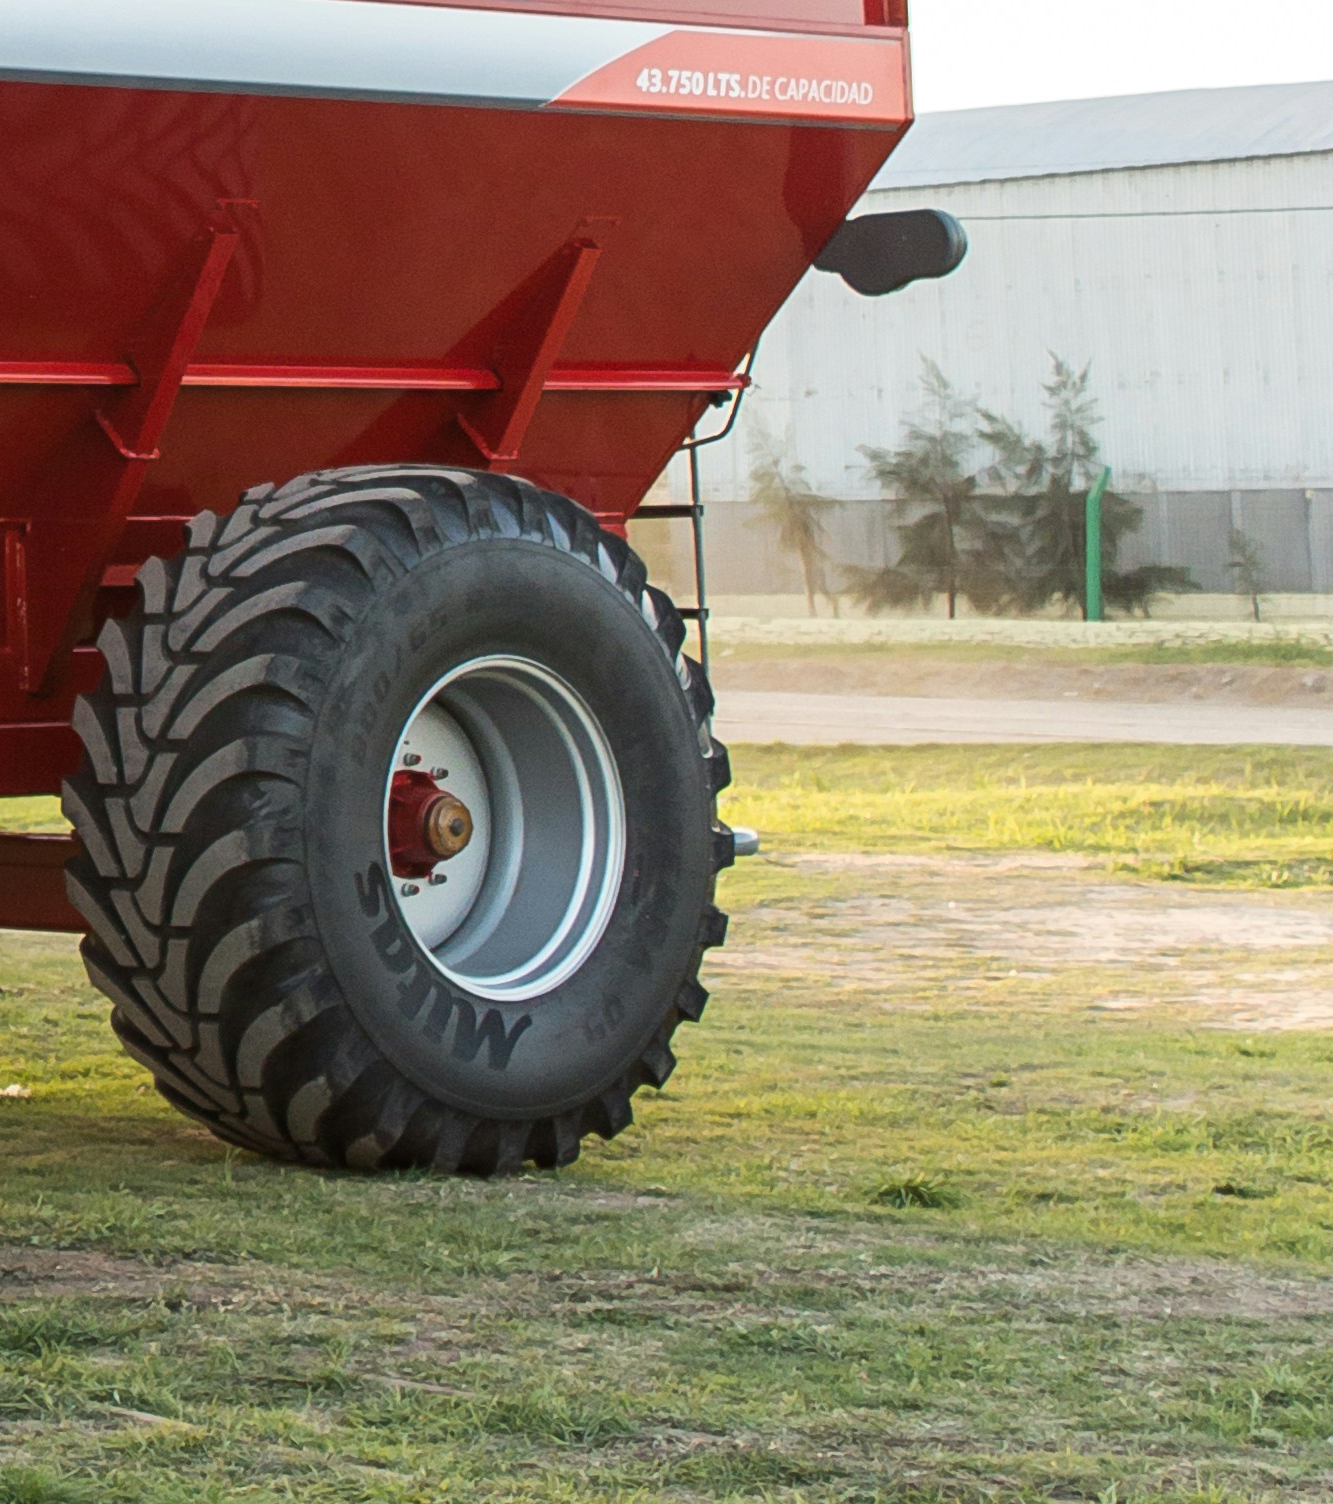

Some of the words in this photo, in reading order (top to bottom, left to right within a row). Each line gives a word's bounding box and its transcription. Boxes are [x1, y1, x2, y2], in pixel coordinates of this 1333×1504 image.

[636, 68, 704, 95] 43.750
[707, 72, 745, 98] LTS.
[748, 75, 770, 99] DE
[775, 77, 873, 105] CAPACIDAD
[354, 862, 532, 1069] Mitas
